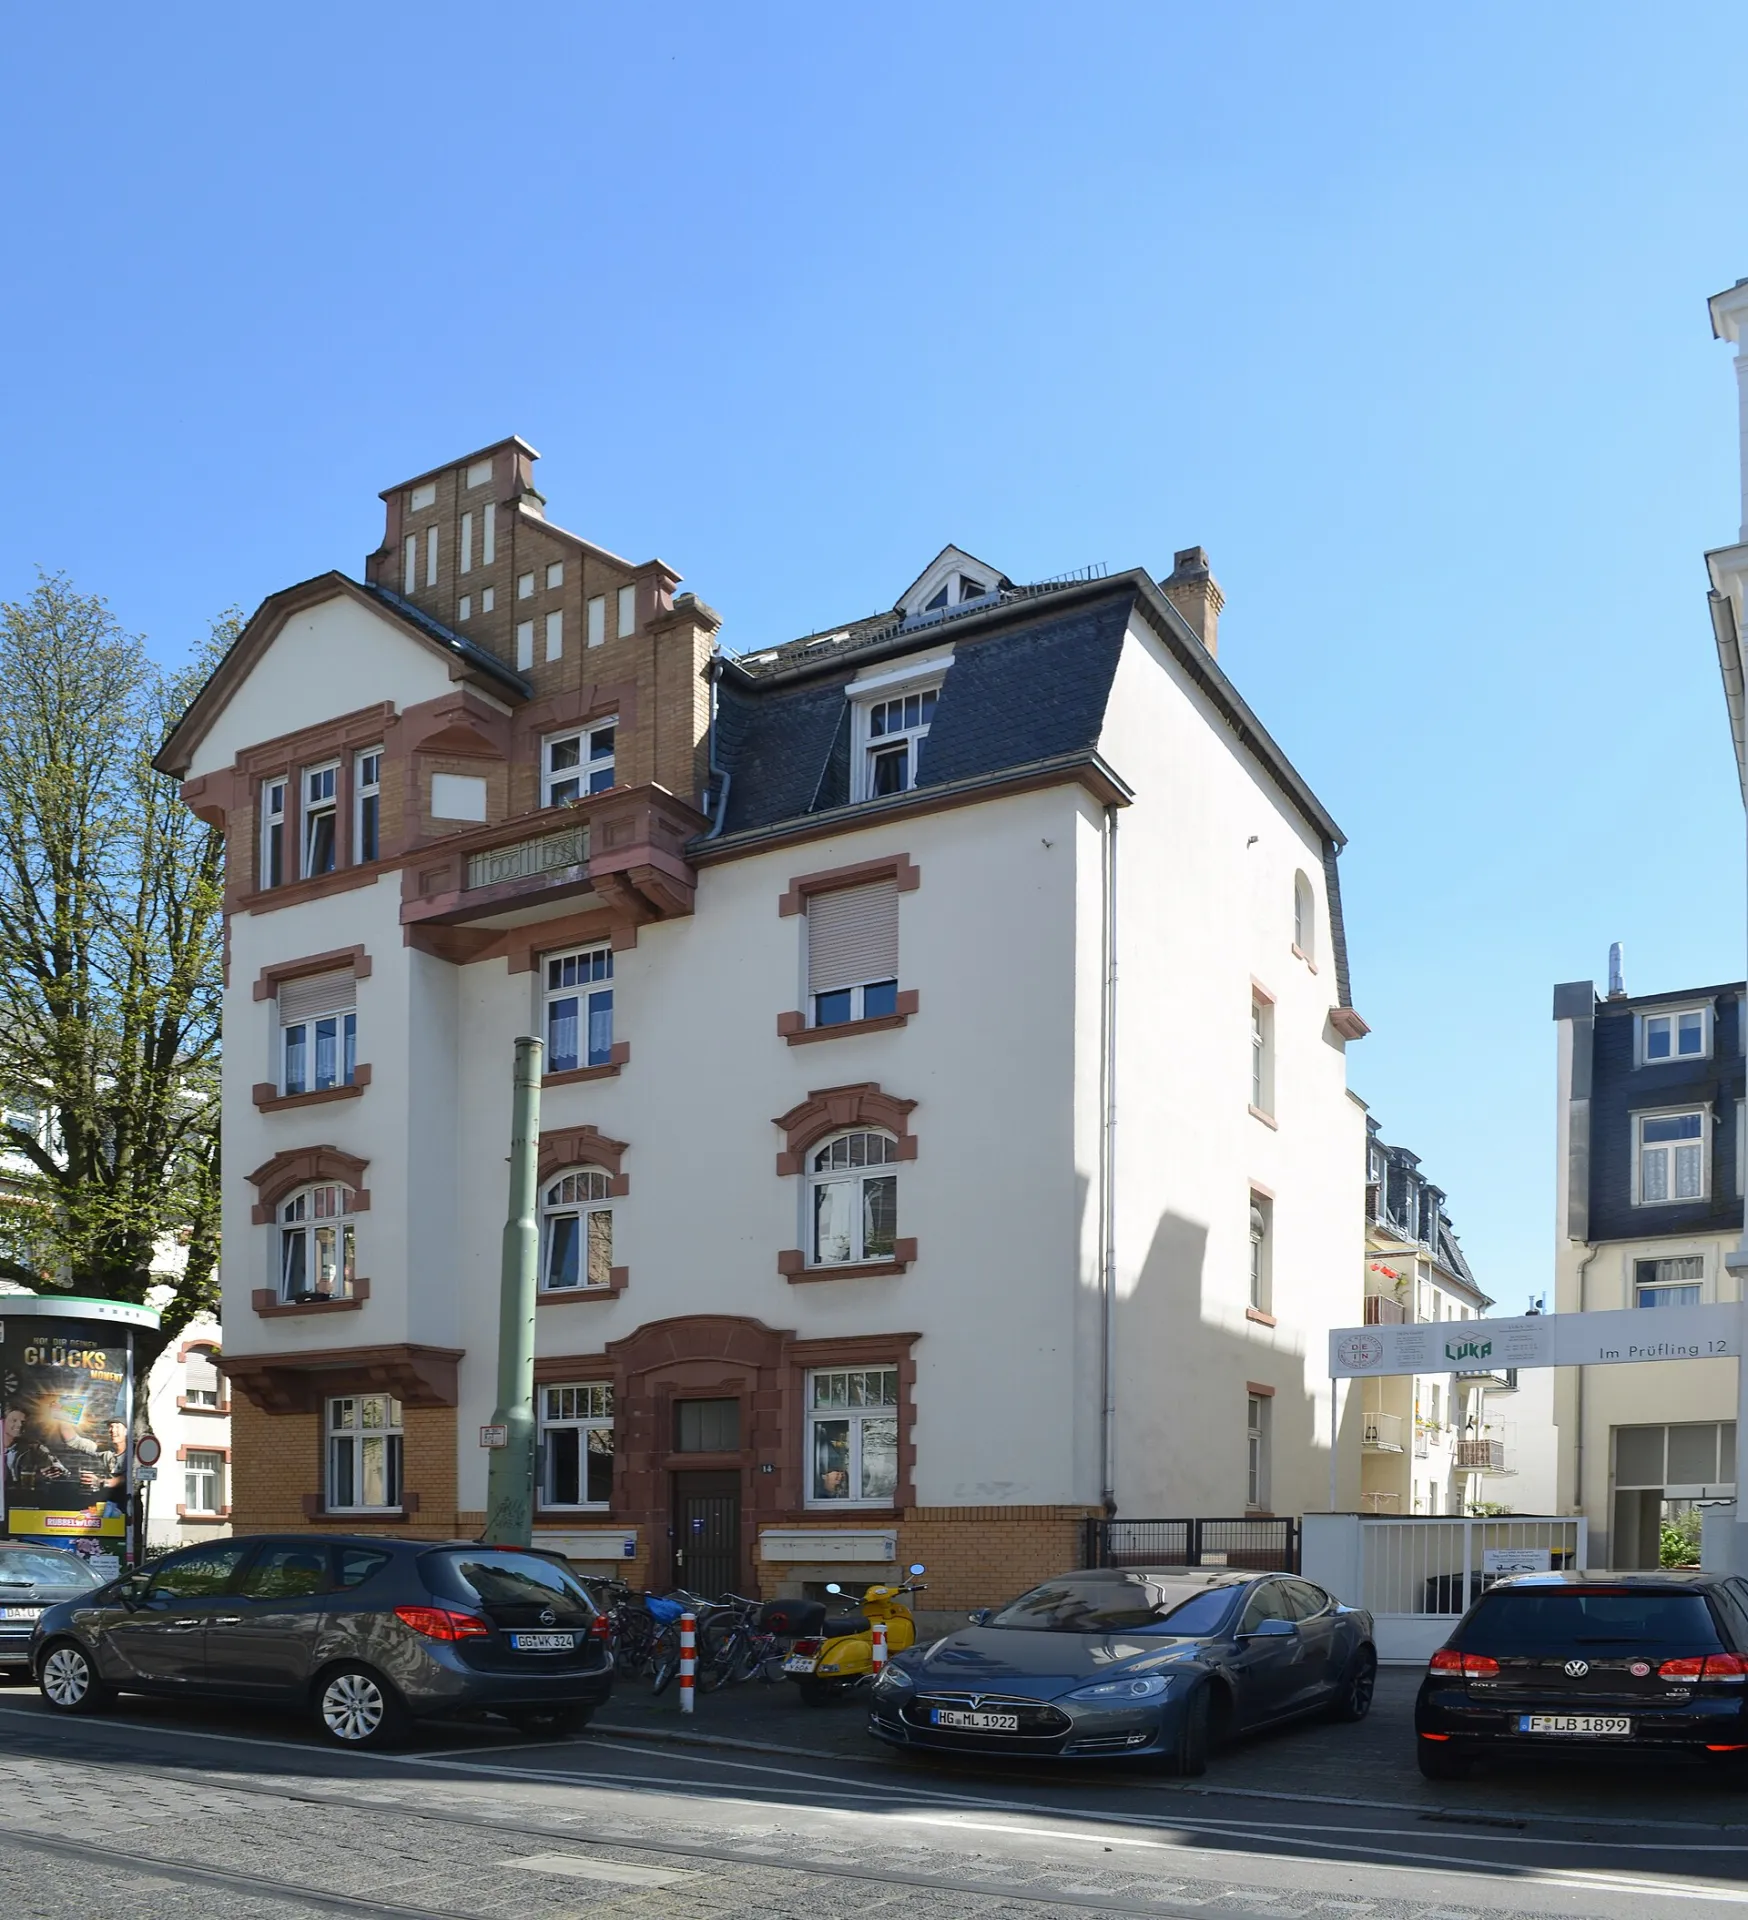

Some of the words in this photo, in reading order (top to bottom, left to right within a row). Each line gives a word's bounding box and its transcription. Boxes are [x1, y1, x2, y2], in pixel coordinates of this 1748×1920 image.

[52, 1338, 67, 1346] DIR
[1445, 1341, 1492, 1360] LUKA
[1600, 1347, 1619, 1359] Im
[1628, 1343, 1699, 1357] Prüfling
[1707, 1340, 1727, 1353] 12
[24, 1345, 107, 1370] GLÜCKS
[90, 1369, 124, 1383] MOMENT
[518, 1635, 533, 1647] GG
[537, 1635, 553, 1647] WK
[553, 1635, 573, 1647] 324
[939, 1710, 954, 1724] HG
[963, 1713, 979, 1726] ML
[982, 1715, 1016, 1729] 1922
[1530, 1717, 1542, 1730] F
[1554, 1718, 1578, 1731] LB
[1581, 1718, 1628, 1732] 1899
